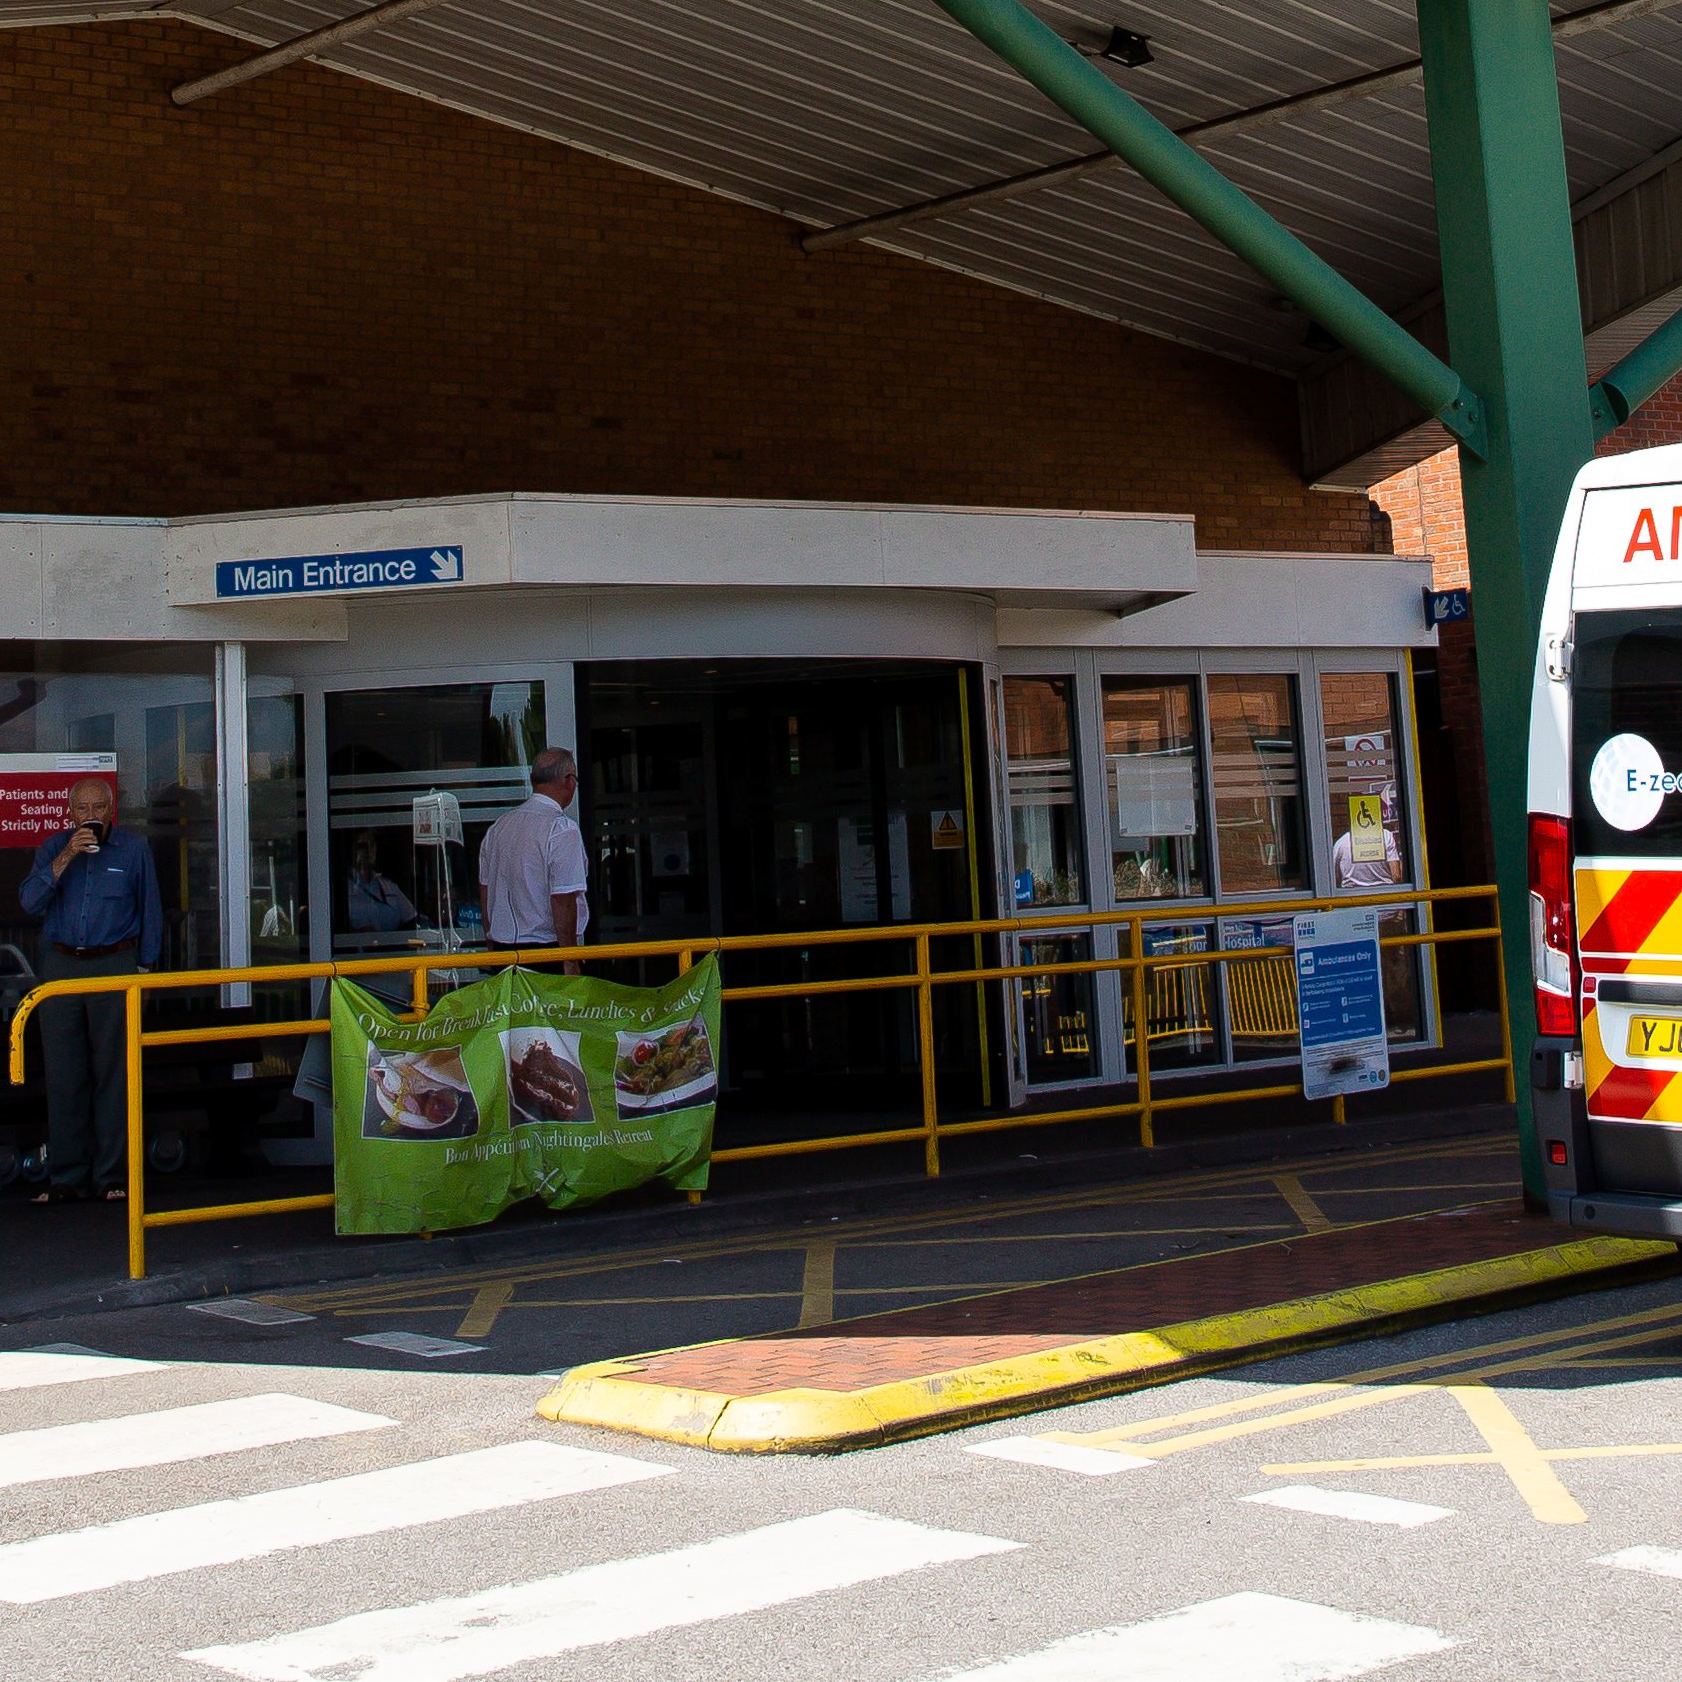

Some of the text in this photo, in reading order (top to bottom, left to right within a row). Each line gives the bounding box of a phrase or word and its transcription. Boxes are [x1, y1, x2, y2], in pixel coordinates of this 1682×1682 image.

[234, 559, 416, 591] Main Entrance
[47, 787, 68, 799] and
[20, 804, 63, 817] Seating
[1, 819, 41, 833] Strictly
[44, 819, 60, 830] No
[358, 1012, 411, 1041] Open
[416, 1021, 439, 1041] for
[567, 998, 637, 1019] Lunches
[640, 1006, 657, 1023] &
[532, 1129, 614, 1152] Nightingales
